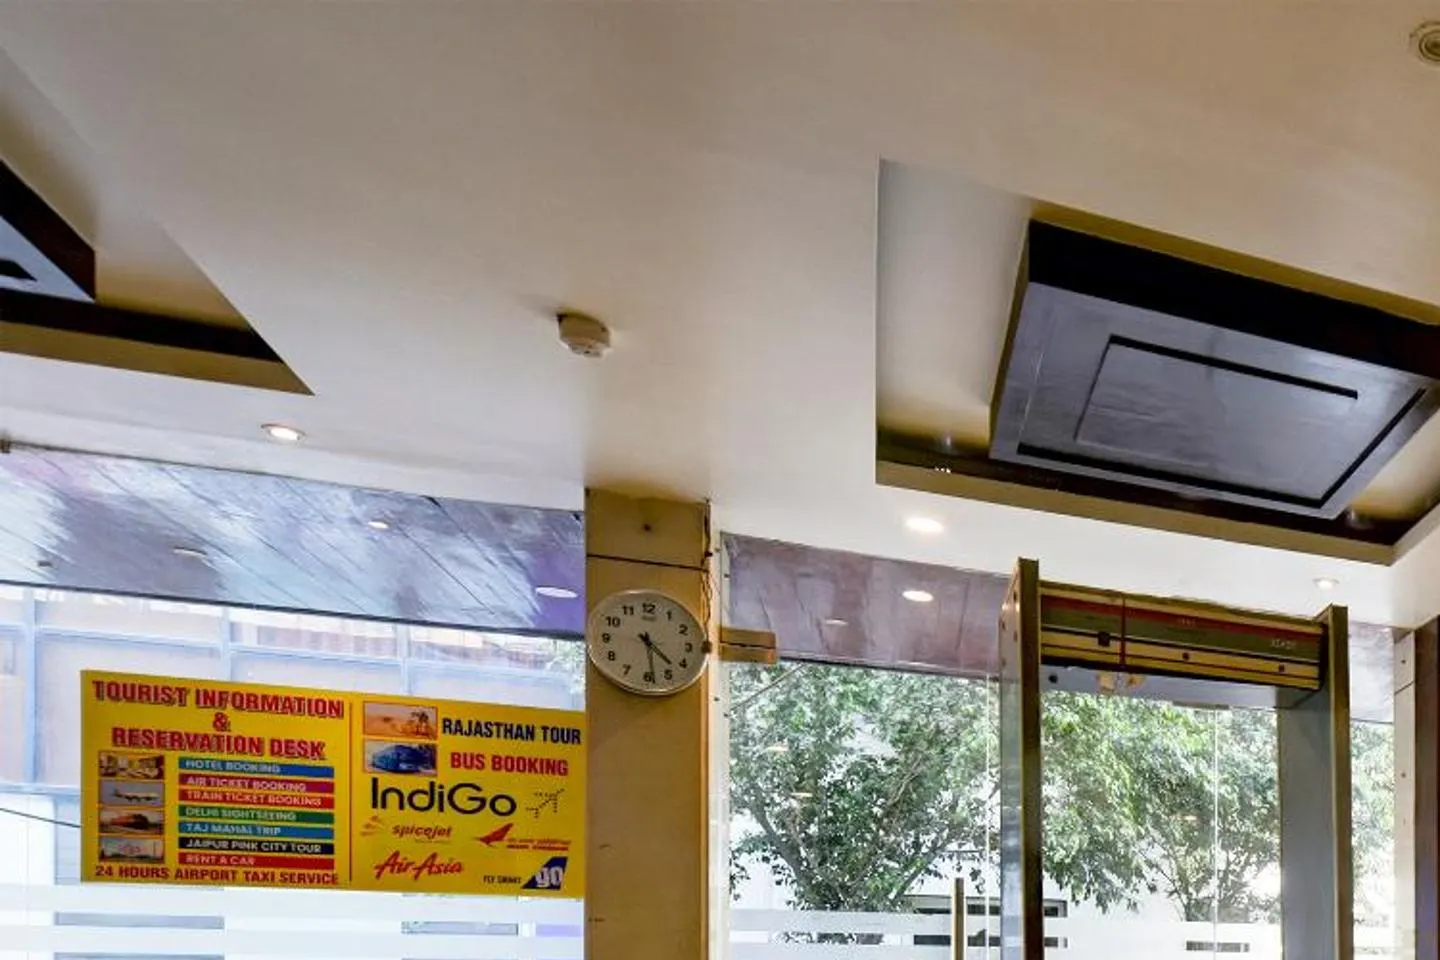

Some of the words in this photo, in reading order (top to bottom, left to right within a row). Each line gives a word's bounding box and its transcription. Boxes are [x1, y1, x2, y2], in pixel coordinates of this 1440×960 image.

[622, 605, 635, 616] 11
[642, 602, 656, 614] 12
[667, 610, 673, 620] 1
[606, 616, 621, 628] 10
[679, 624, 689, 635] 2
[601, 632, 611, 643] 9
[685, 642, 694, 653] 3
[607, 650, 616, 661] 8
[622, 664, 632, 675] 7
[679, 658, 688, 669] 4
[643, 671, 652, 682] 6
[664, 669, 673, 681] 5
[92, 680, 189, 707] TOURIST
[196, 689, 344, 719] INFORMATION
[212, 712, 231, 732] &
[441, 717, 536, 743] RAJASTHAN
[541, 725, 581, 745] TOUR
[112, 727, 264, 758] RESERVATION
[270, 738, 326, 760] DESK
[186, 760, 223, 771] HOTEL
[226, 762, 281, 773] BOOKING
[450, 751, 486, 770] BUS
[491, 754, 568, 777] BOOKING
[186, 776, 204, 786] AIR
[206, 777, 249, 788] TICKET
[252, 780, 307, 792] BOOKING
[186, 790, 223, 801] TRAIN
[226, 792, 264, 803] TICKET
[267, 795, 321, 806] BOOKING
[371, 776, 517, 817] IndiGo
[185, 807, 220, 817] DELHI
[186, 823, 209, 832] TAJ
[211, 824, 253, 834] MAHAL
[256, 826, 282, 836] TRIP
[186, 839, 229, 849] JAIPUR
[231, 840, 258, 851] PINK
[261, 842, 290, 852] CITY
[291, 843, 322, 854] TOUR
[185, 853, 217, 864] RENT
[218, 855, 228, 865] A
[95, 865, 114, 877] 24
[118, 866, 170, 880] HOURS
[174, 868, 238, 882] AIRPORT
[243, 870, 275, 883] TAXI
[279, 872, 339, 886] SERVICE
